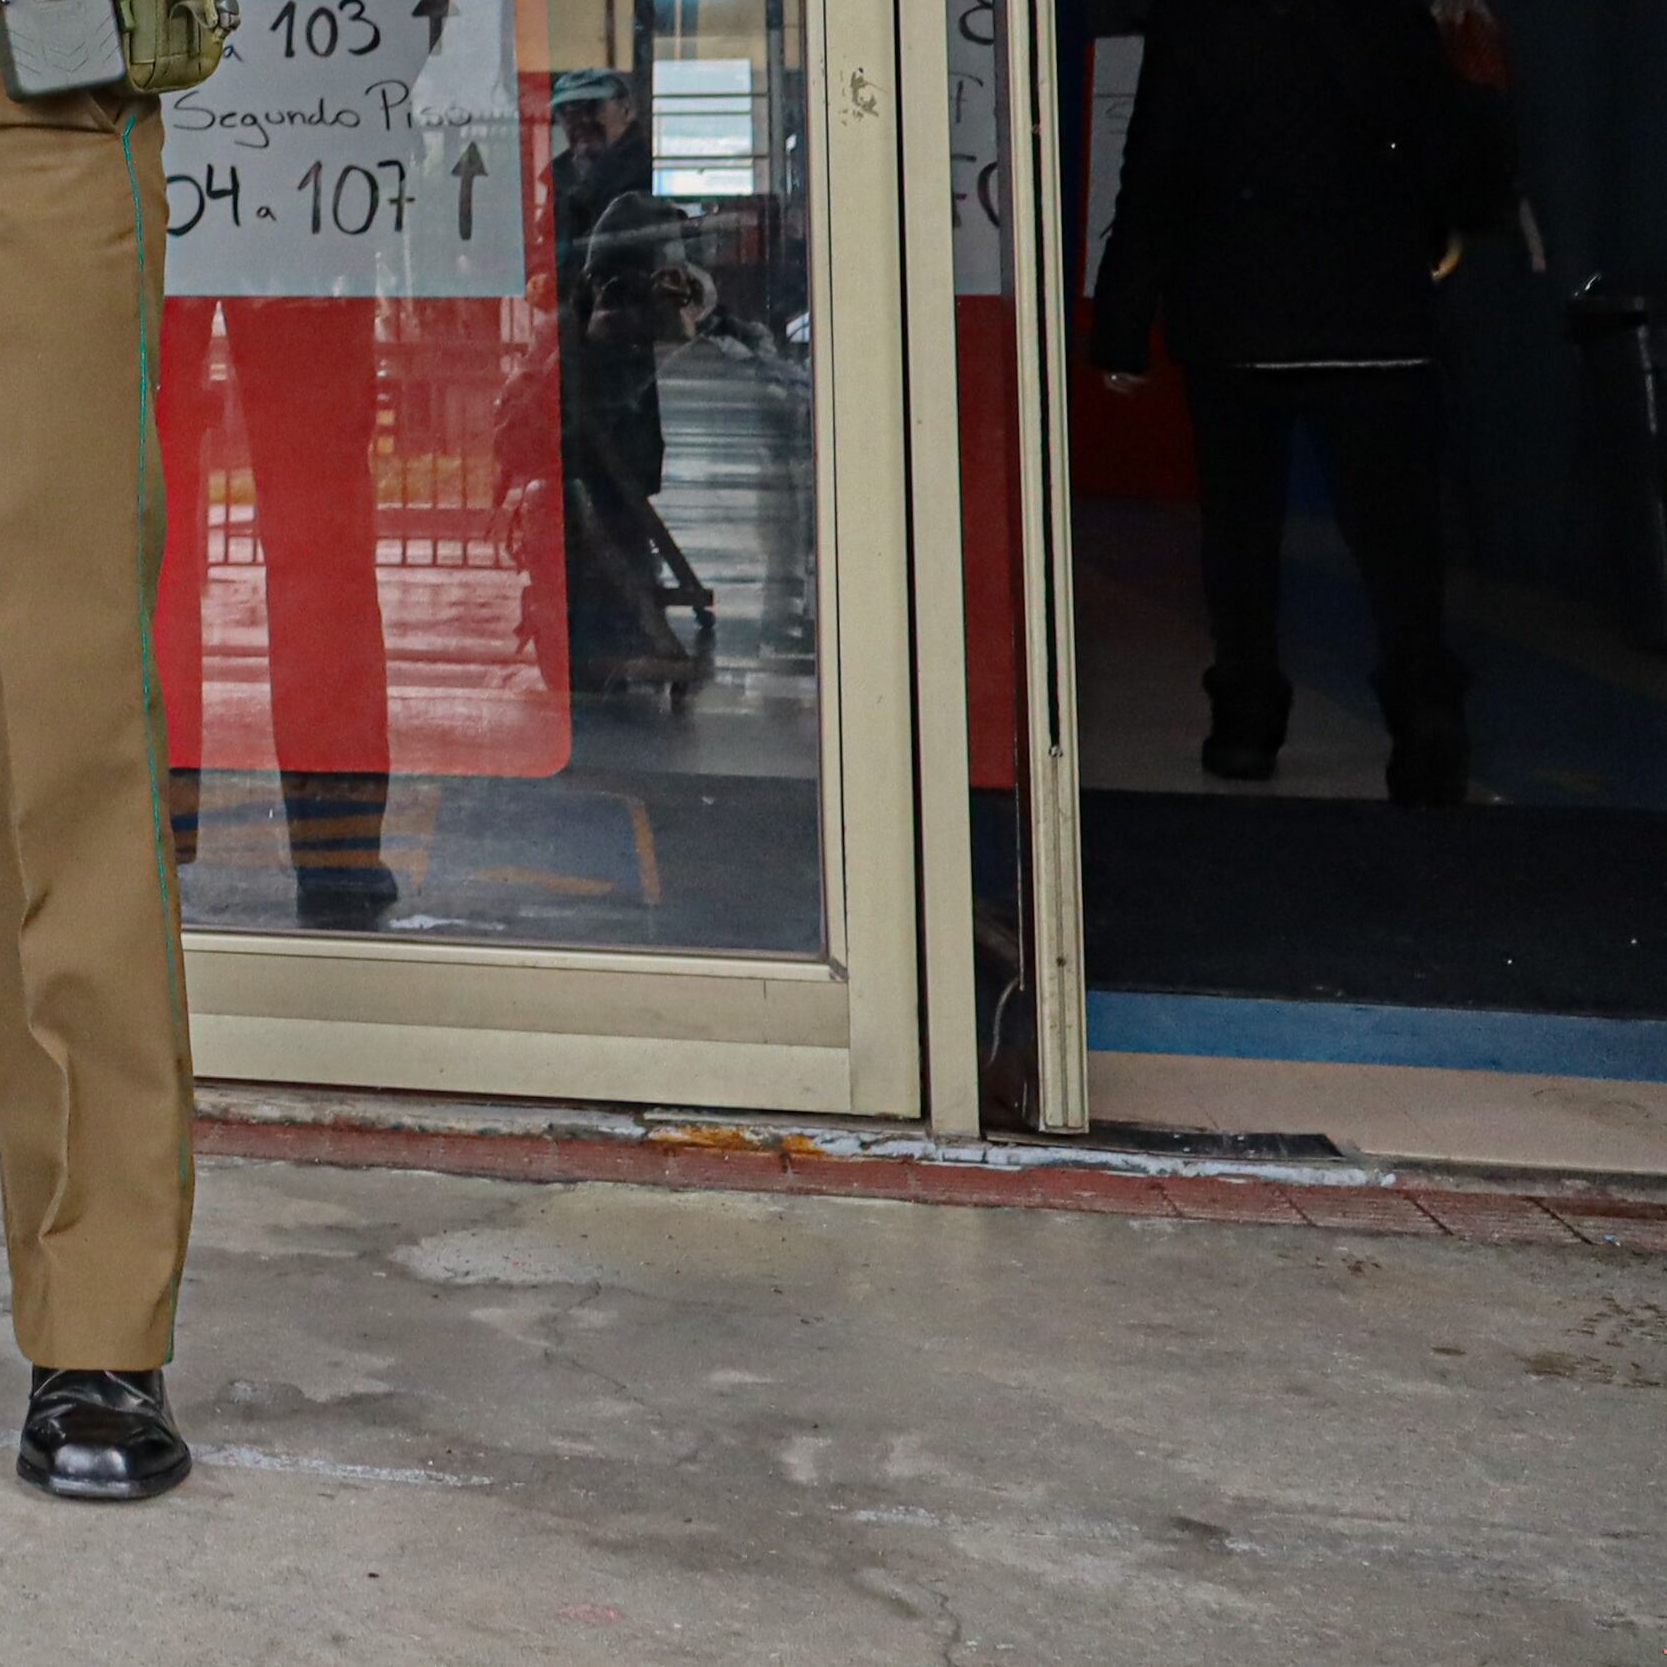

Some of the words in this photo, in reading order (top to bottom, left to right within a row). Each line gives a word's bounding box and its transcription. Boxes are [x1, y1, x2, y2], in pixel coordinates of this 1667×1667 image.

[173, 90, 361, 149] Segundo
[365, 79, 473, 131] Piso
[167, 163, 241, 236] 04
[256, 204, 276, 222] a
[297, 160, 415, 236] 107
